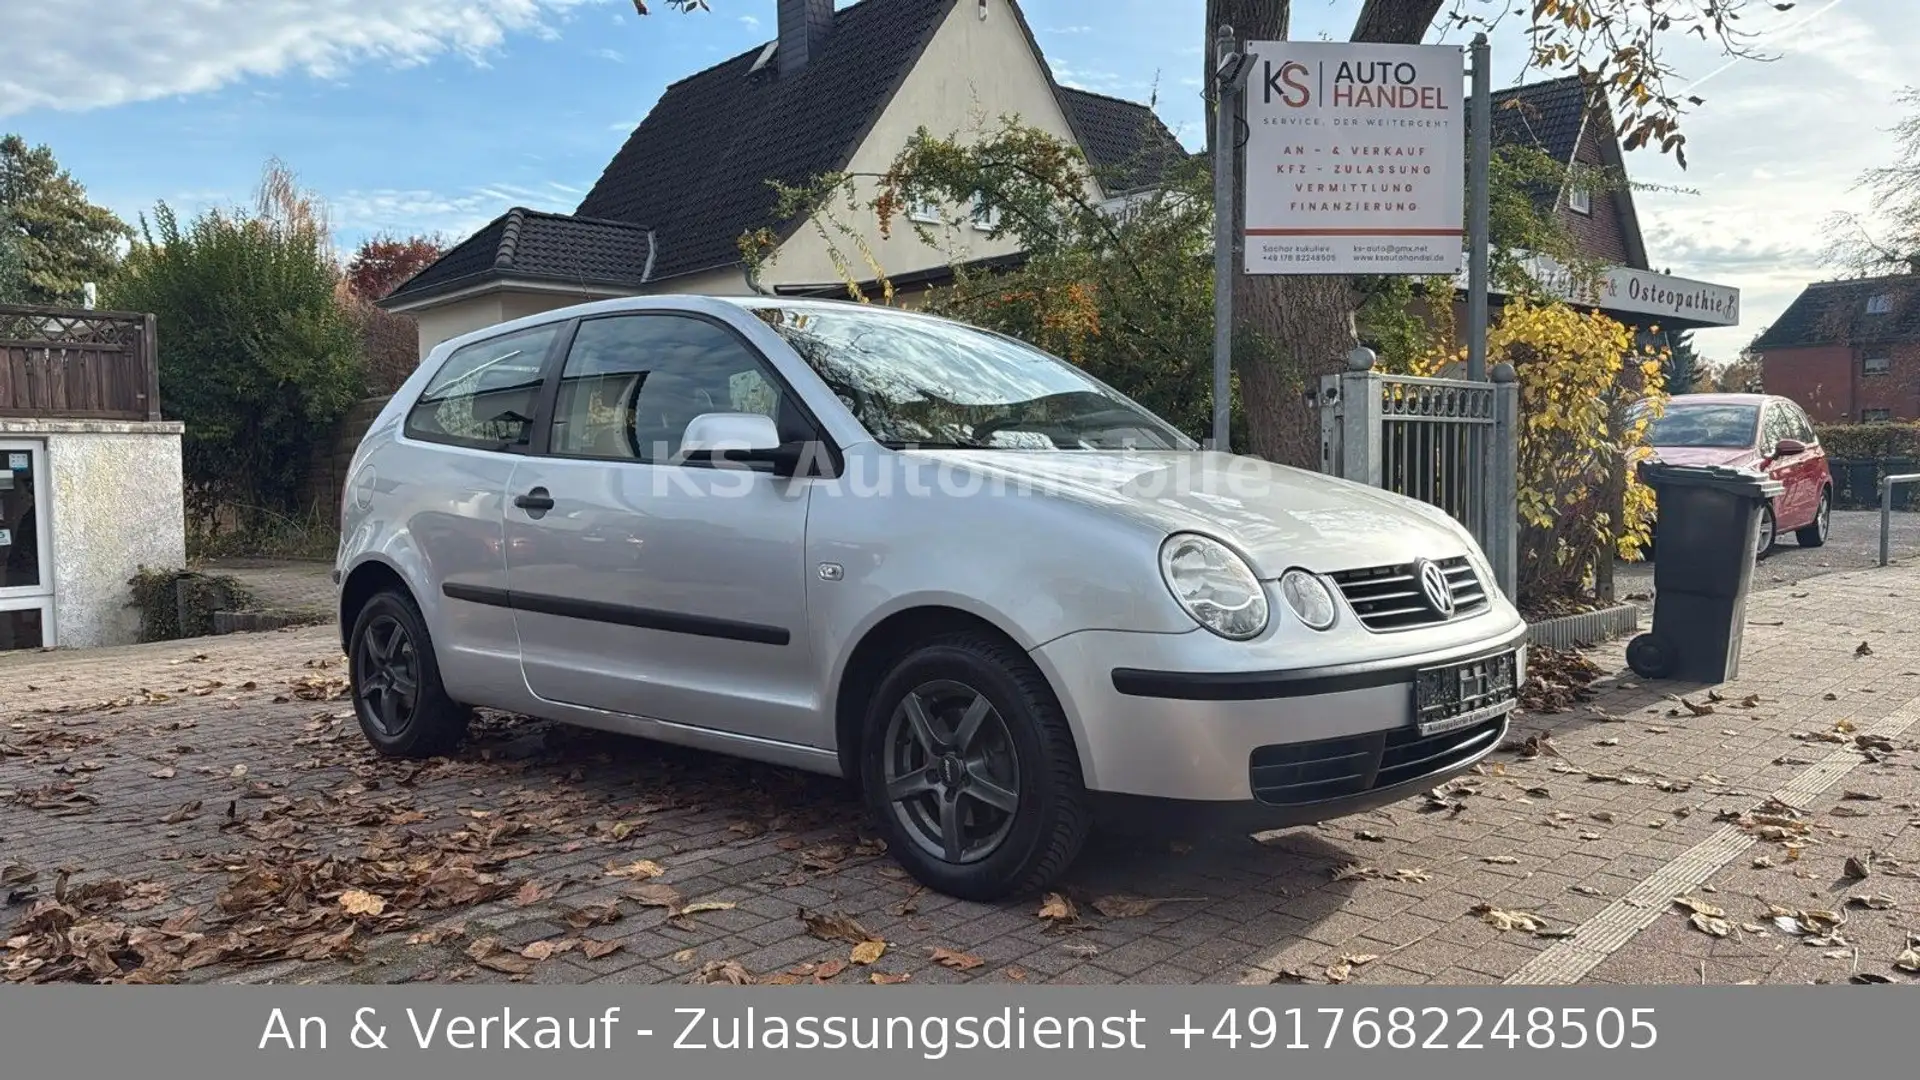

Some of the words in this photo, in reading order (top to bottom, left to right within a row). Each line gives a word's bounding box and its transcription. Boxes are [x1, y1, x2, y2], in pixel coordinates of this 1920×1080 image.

[1334, 60, 1417, 86] AUTO
[1263, 59, 1311, 109] KS
[1333, 85, 1449, 110] HANDEL
[1333, 118, 1364, 127] DER
[1366, 118, 1449, 128] WEITERGEHT
[1283, 145, 1305, 156] AN
[1331, 145, 1341, 156] &
[1351, 145, 1426, 157] VERKAUF
[1276, 164, 1307, 174] KFZ
[1333, 164, 1432, 175] ZULASSUNG
[1295, 183, 1414, 193] VERMITTLUNG
[1290, 201, 1418, 212] FINANZIERUNG
[1628, 276, 1724, 313] Osteopathie
